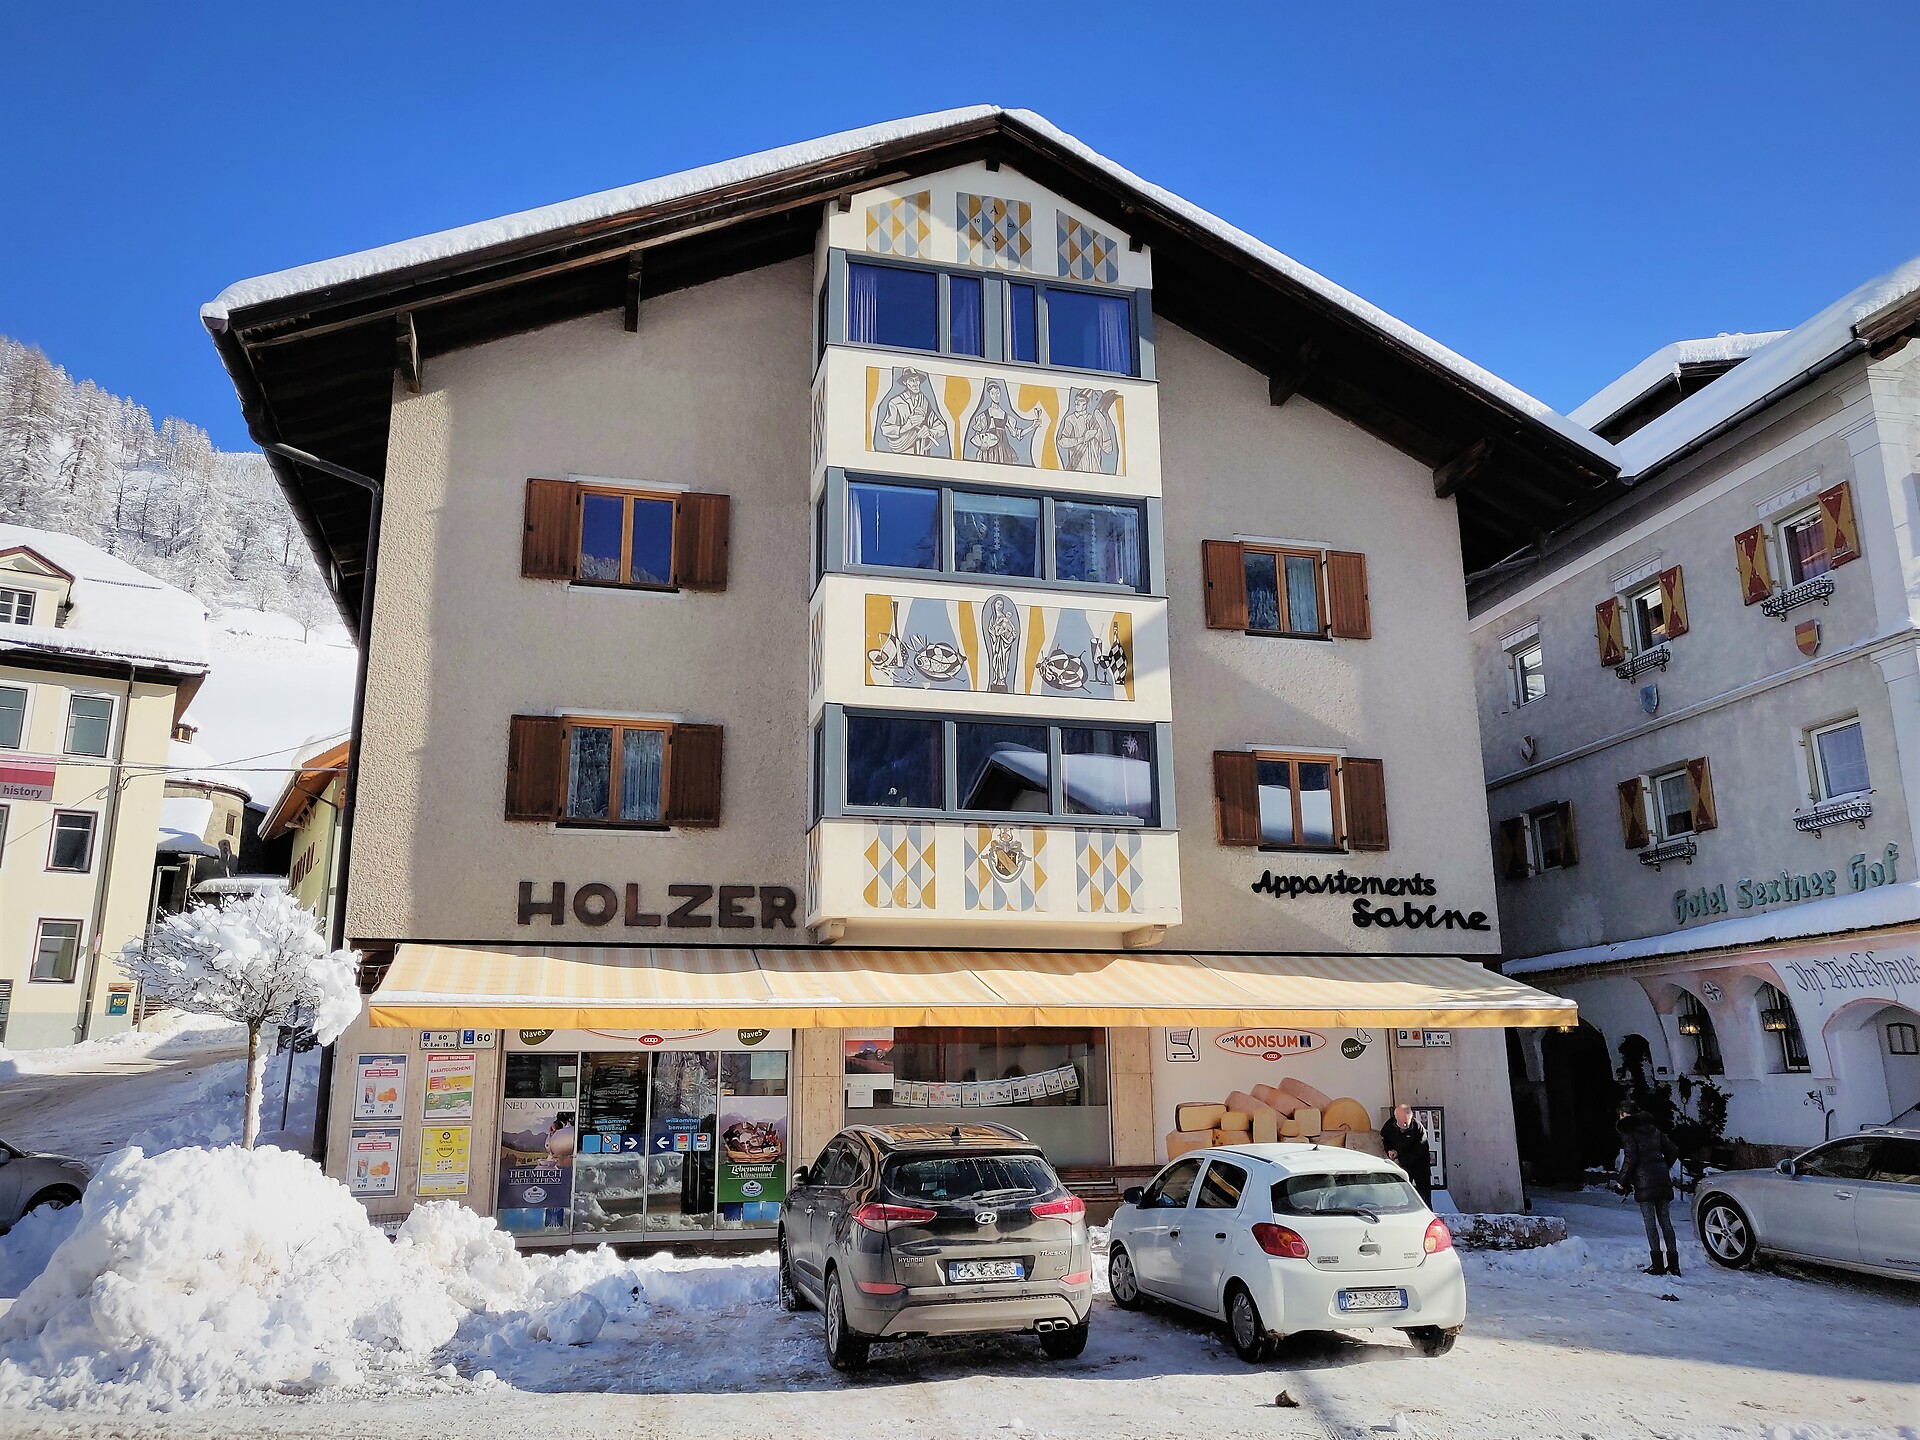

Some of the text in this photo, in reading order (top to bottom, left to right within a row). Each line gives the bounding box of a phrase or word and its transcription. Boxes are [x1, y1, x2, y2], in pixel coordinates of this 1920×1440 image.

[3, 784, 42, 799] history
[1673, 840, 1900, 925] Hotel Sextner Hof
[517, 881, 797, 929] HOLZER
[1352, 898, 1491, 931] Sabine
[1236, 1035, 1298, 1048] KONSUM
[535, 1100, 575, 1110] NOVITÀ
